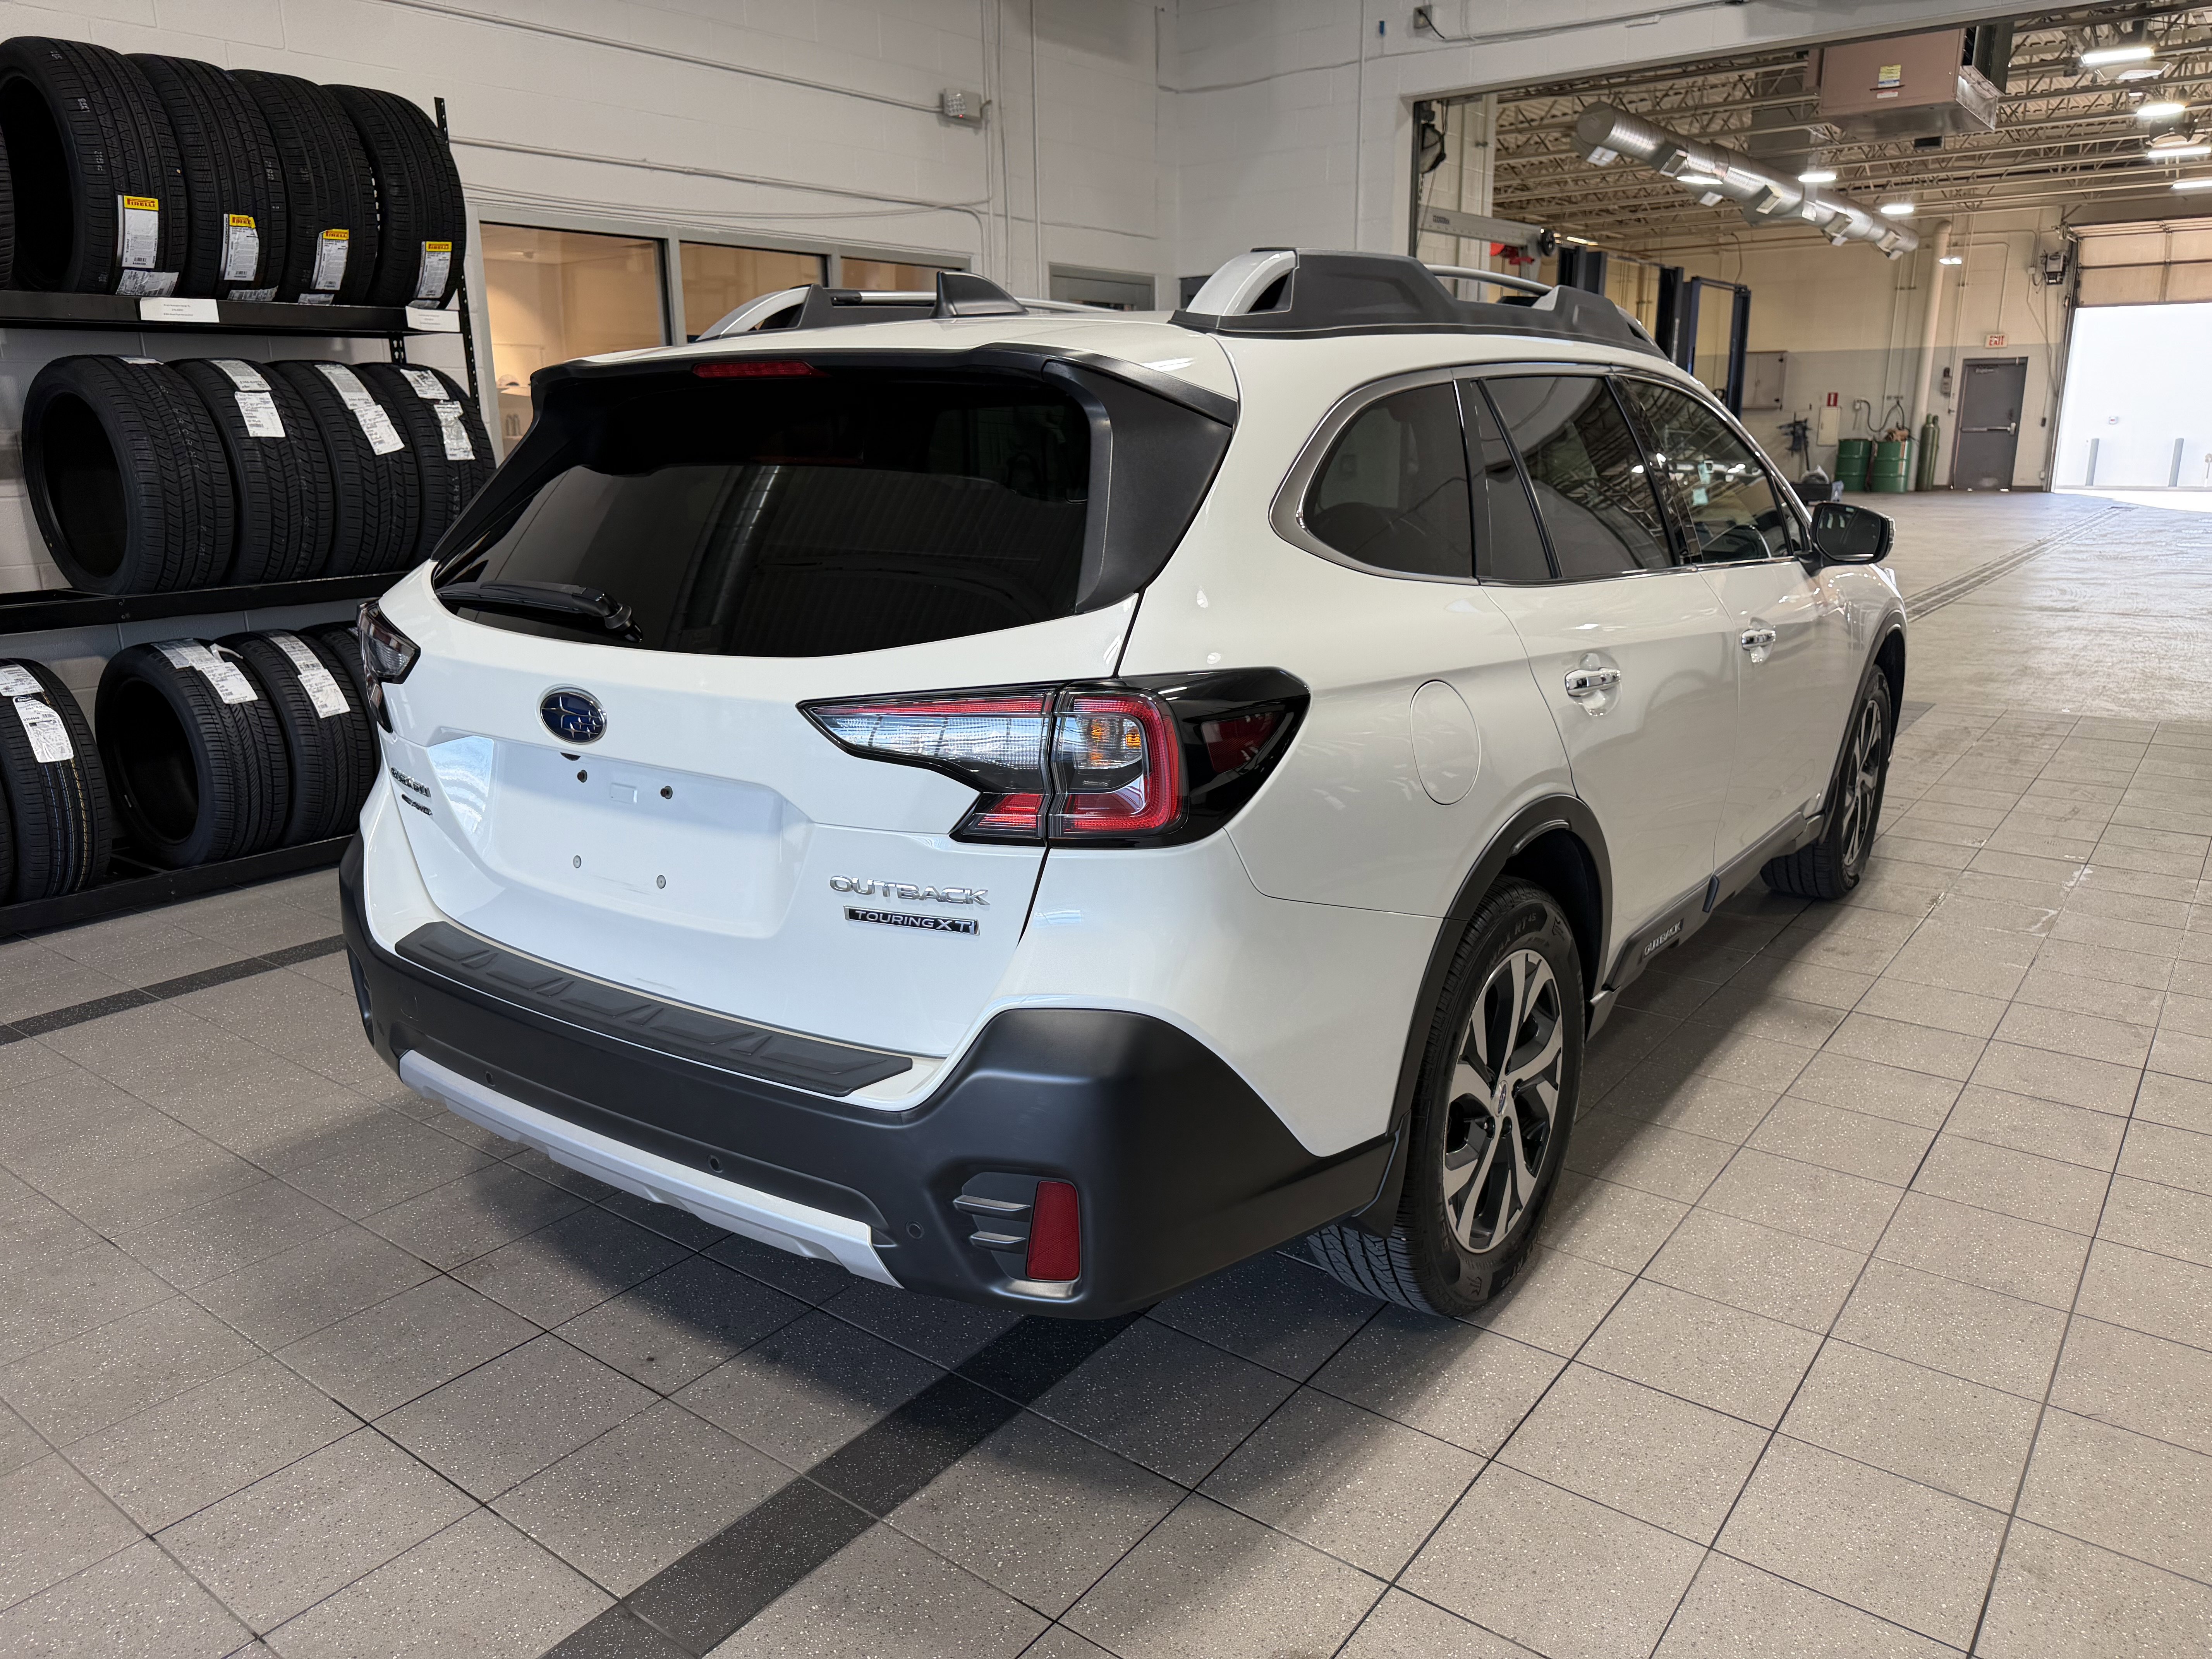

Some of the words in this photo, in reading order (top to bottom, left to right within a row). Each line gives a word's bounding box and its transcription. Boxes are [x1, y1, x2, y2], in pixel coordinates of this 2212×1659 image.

[127, 198, 155, 207] PIRELLI
[1989, 335, 2005, 346] EXIT
[391, 767, 431, 798] SUBARU
[830, 875, 991, 905] OUTBACK
[855, 910, 934, 928] TOURING
[1644, 921, 1681, 956] OUTBACK
